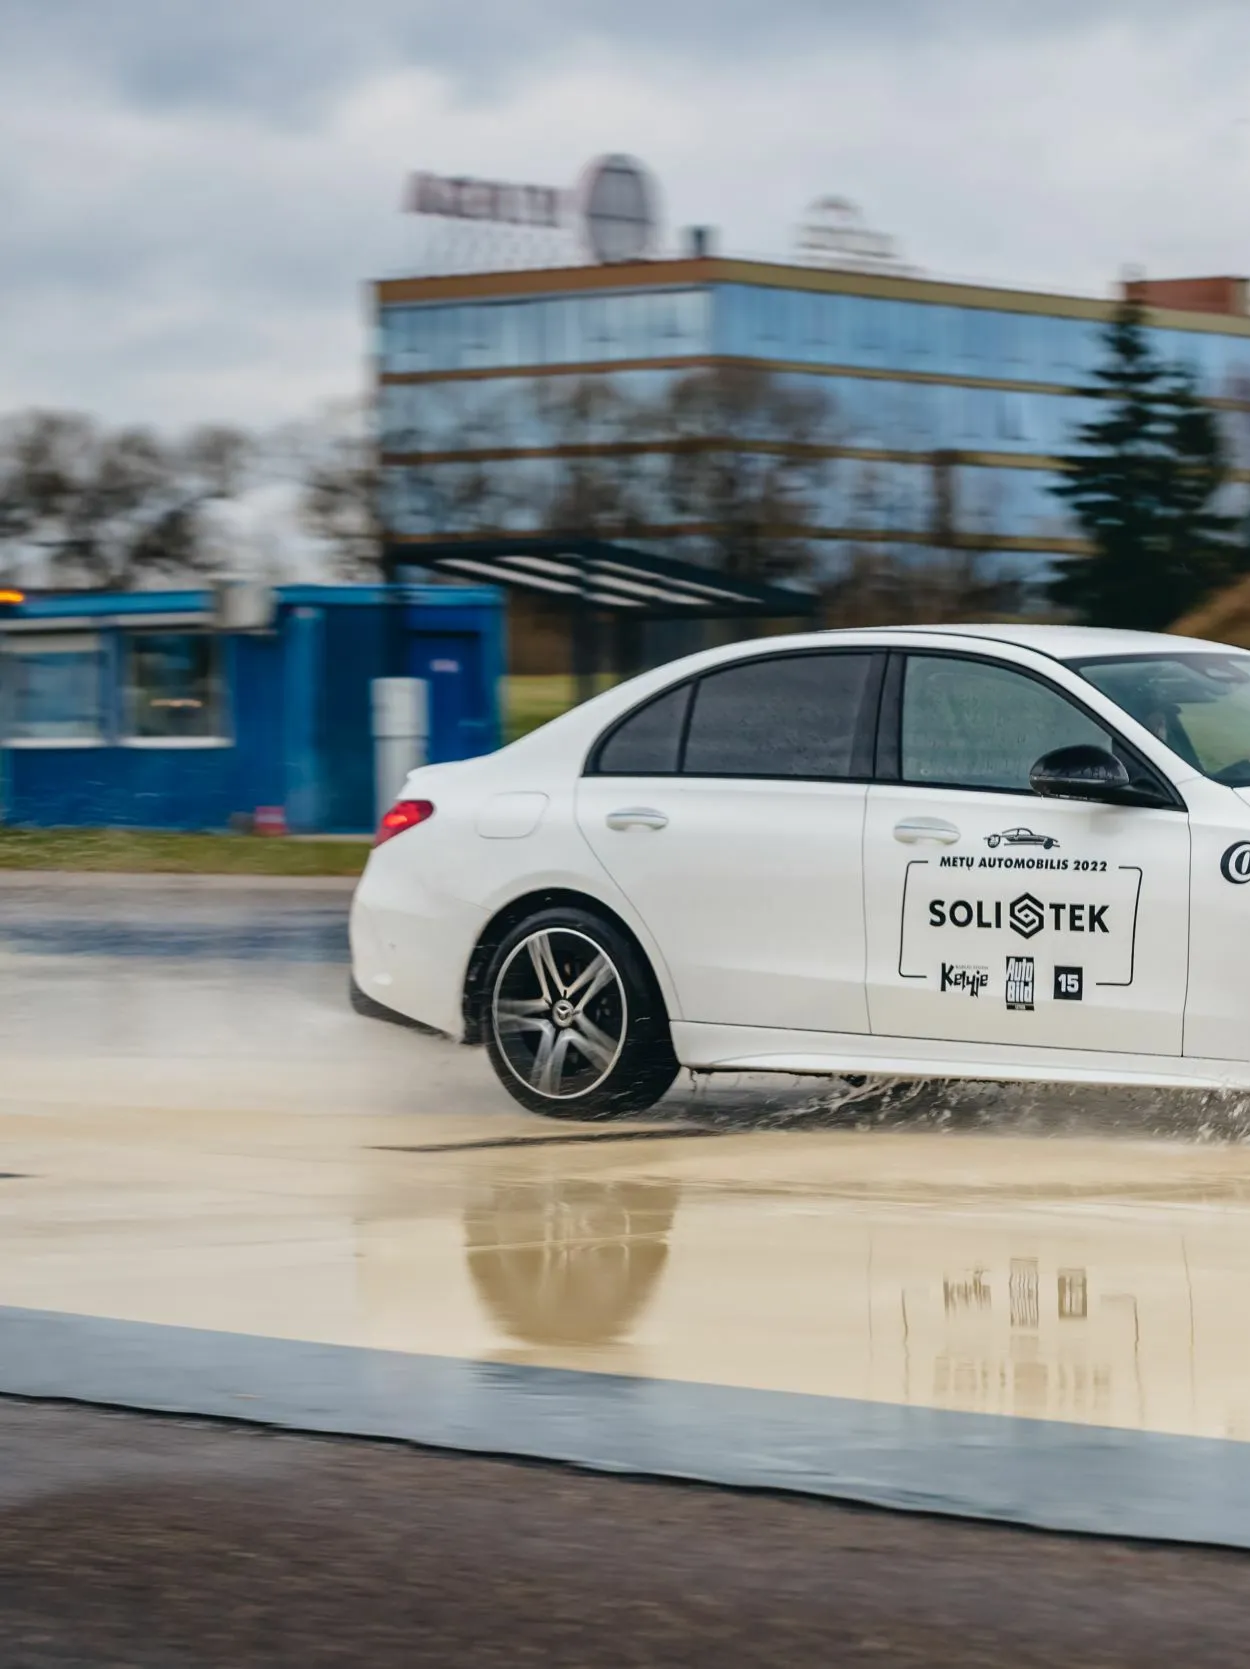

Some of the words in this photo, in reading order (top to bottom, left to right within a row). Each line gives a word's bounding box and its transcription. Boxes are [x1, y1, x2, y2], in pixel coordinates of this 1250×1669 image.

[939, 855, 975, 871] METŲ
[978, 857, 1069, 871] AUTOMOBILIS
[1073, 860, 1108, 872] 2022
[1005, 957, 1034, 981] Auto
[1007, 980, 1033, 1003] Bild
[1058, 973, 1079, 993] 15
